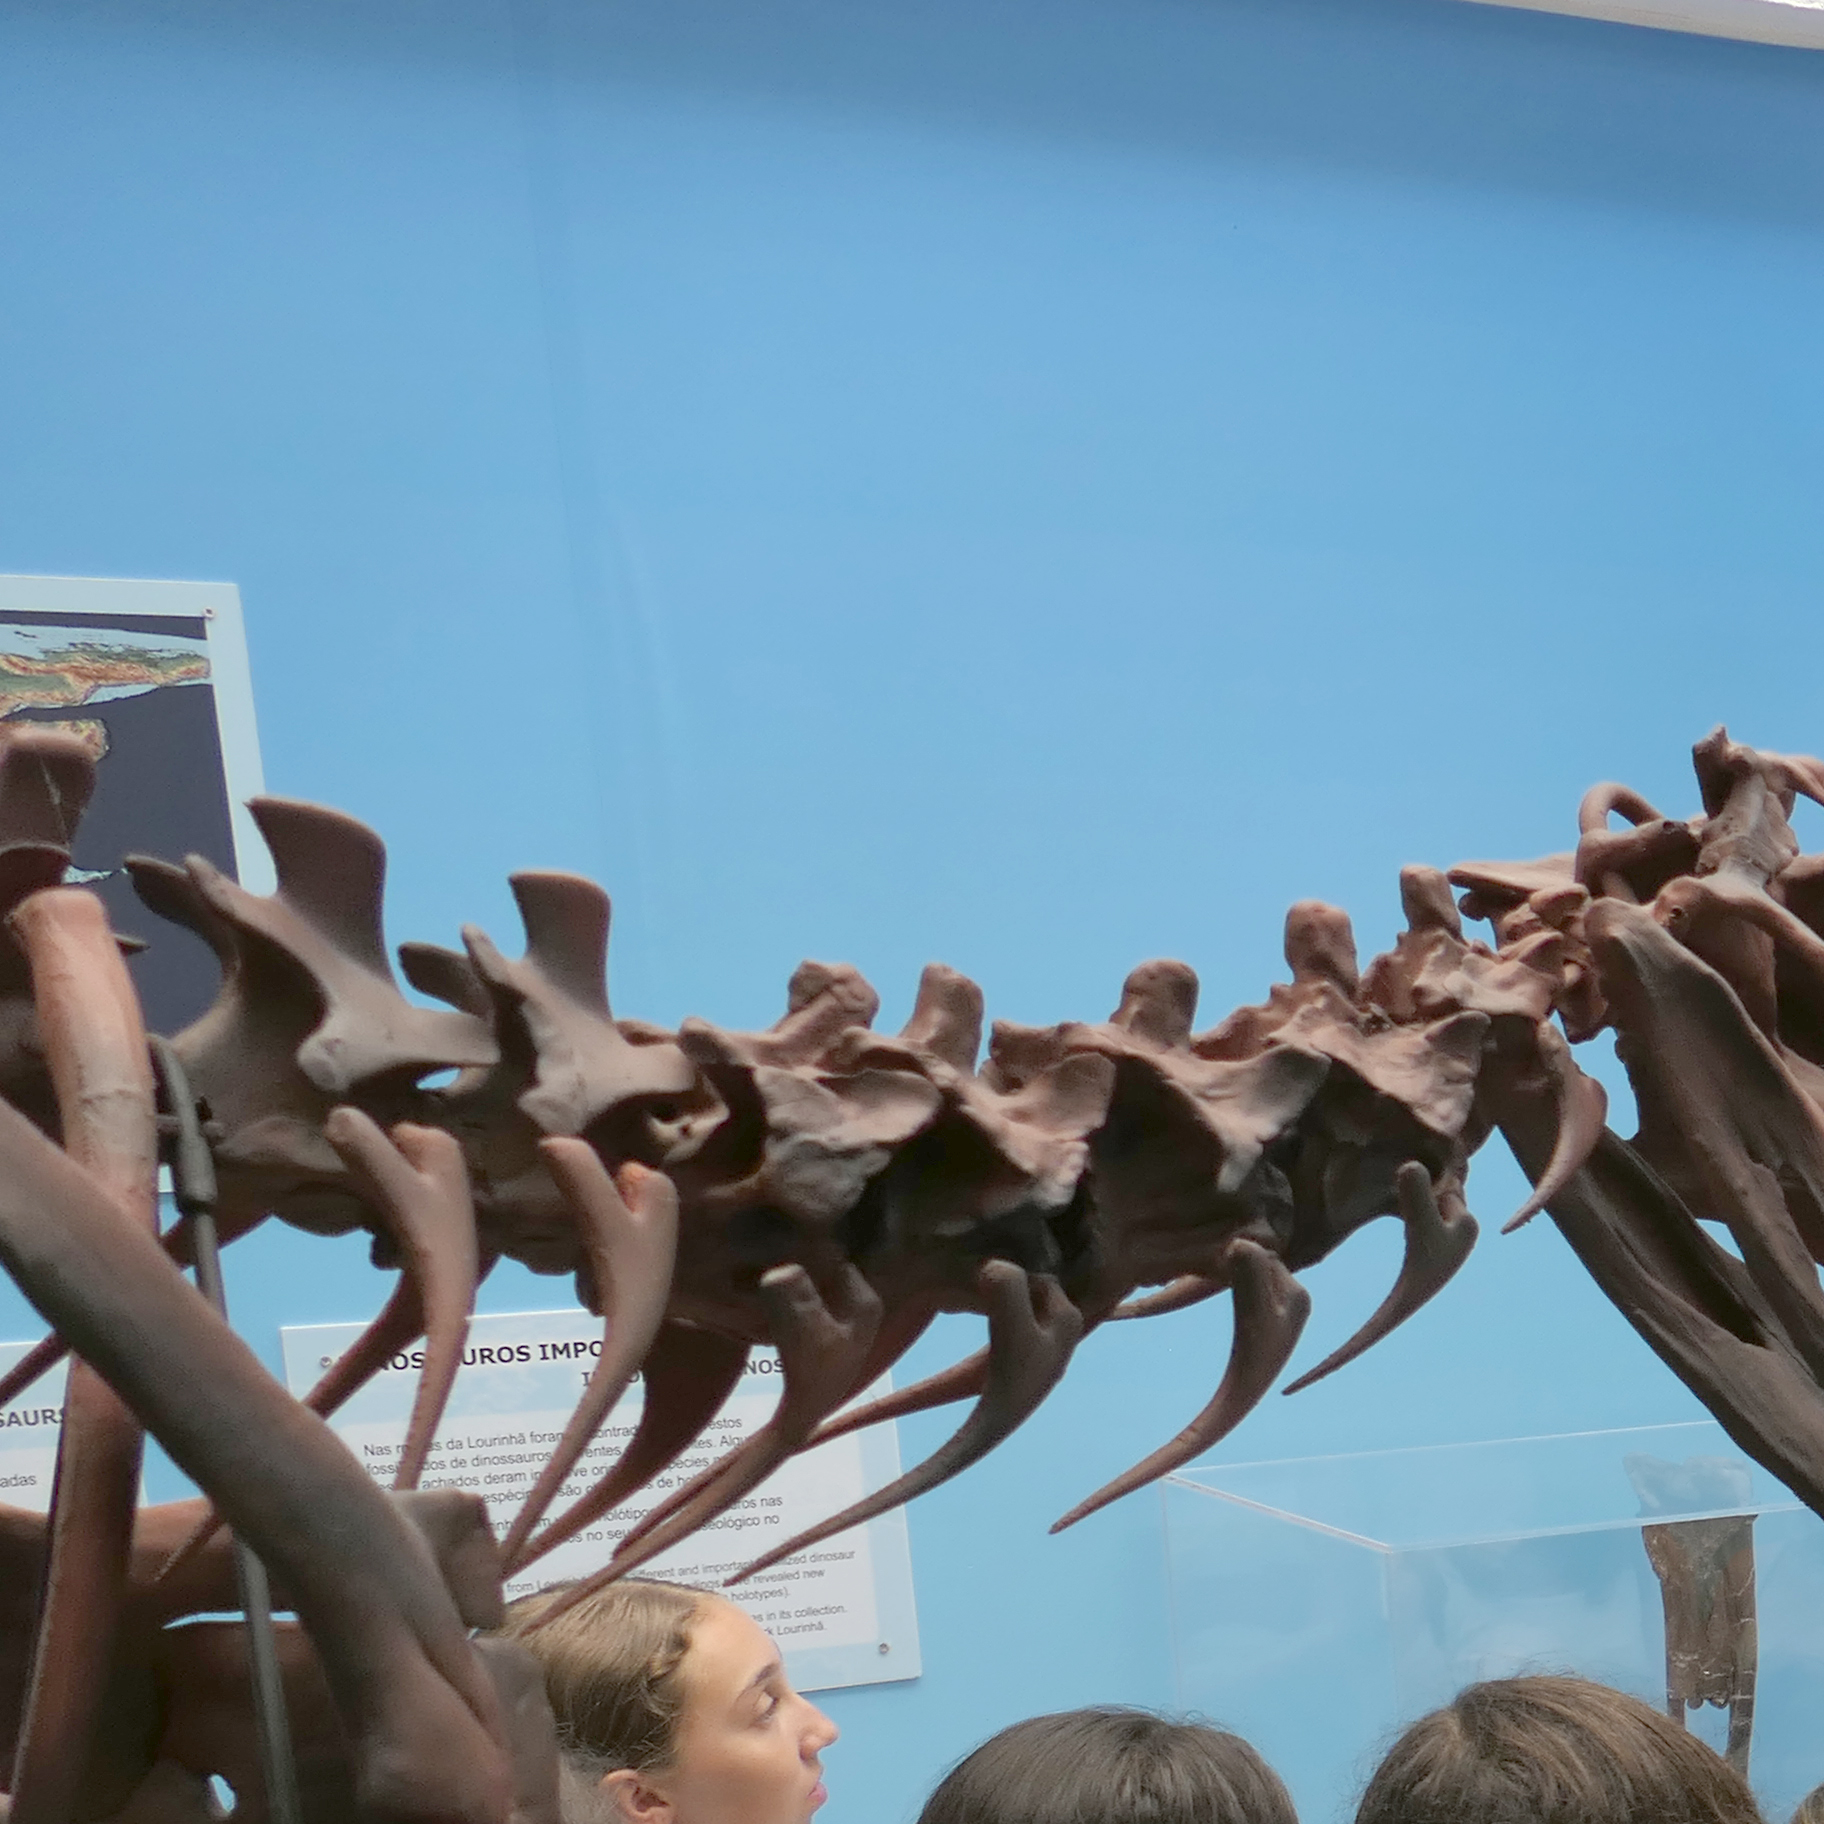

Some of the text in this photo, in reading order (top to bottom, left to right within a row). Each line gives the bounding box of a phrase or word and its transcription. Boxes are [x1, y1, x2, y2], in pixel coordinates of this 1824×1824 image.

[364, 1432, 527, 1456] Nas da Lourinhã
[451, 1450, 551, 1469] de dinossauros
[422, 1471, 526, 1490] achados deram
[657, 1476, 673, 1489] de
[760, 1496, 783, 1507] nas
[587, 1514, 779, 1541] no no
[678, 1565, 699, 1576] and
[809, 1551, 855, 1562] dinosaur
[753, 1569, 825, 1583] revealed new
[766, 1611, 776, 1621] in
